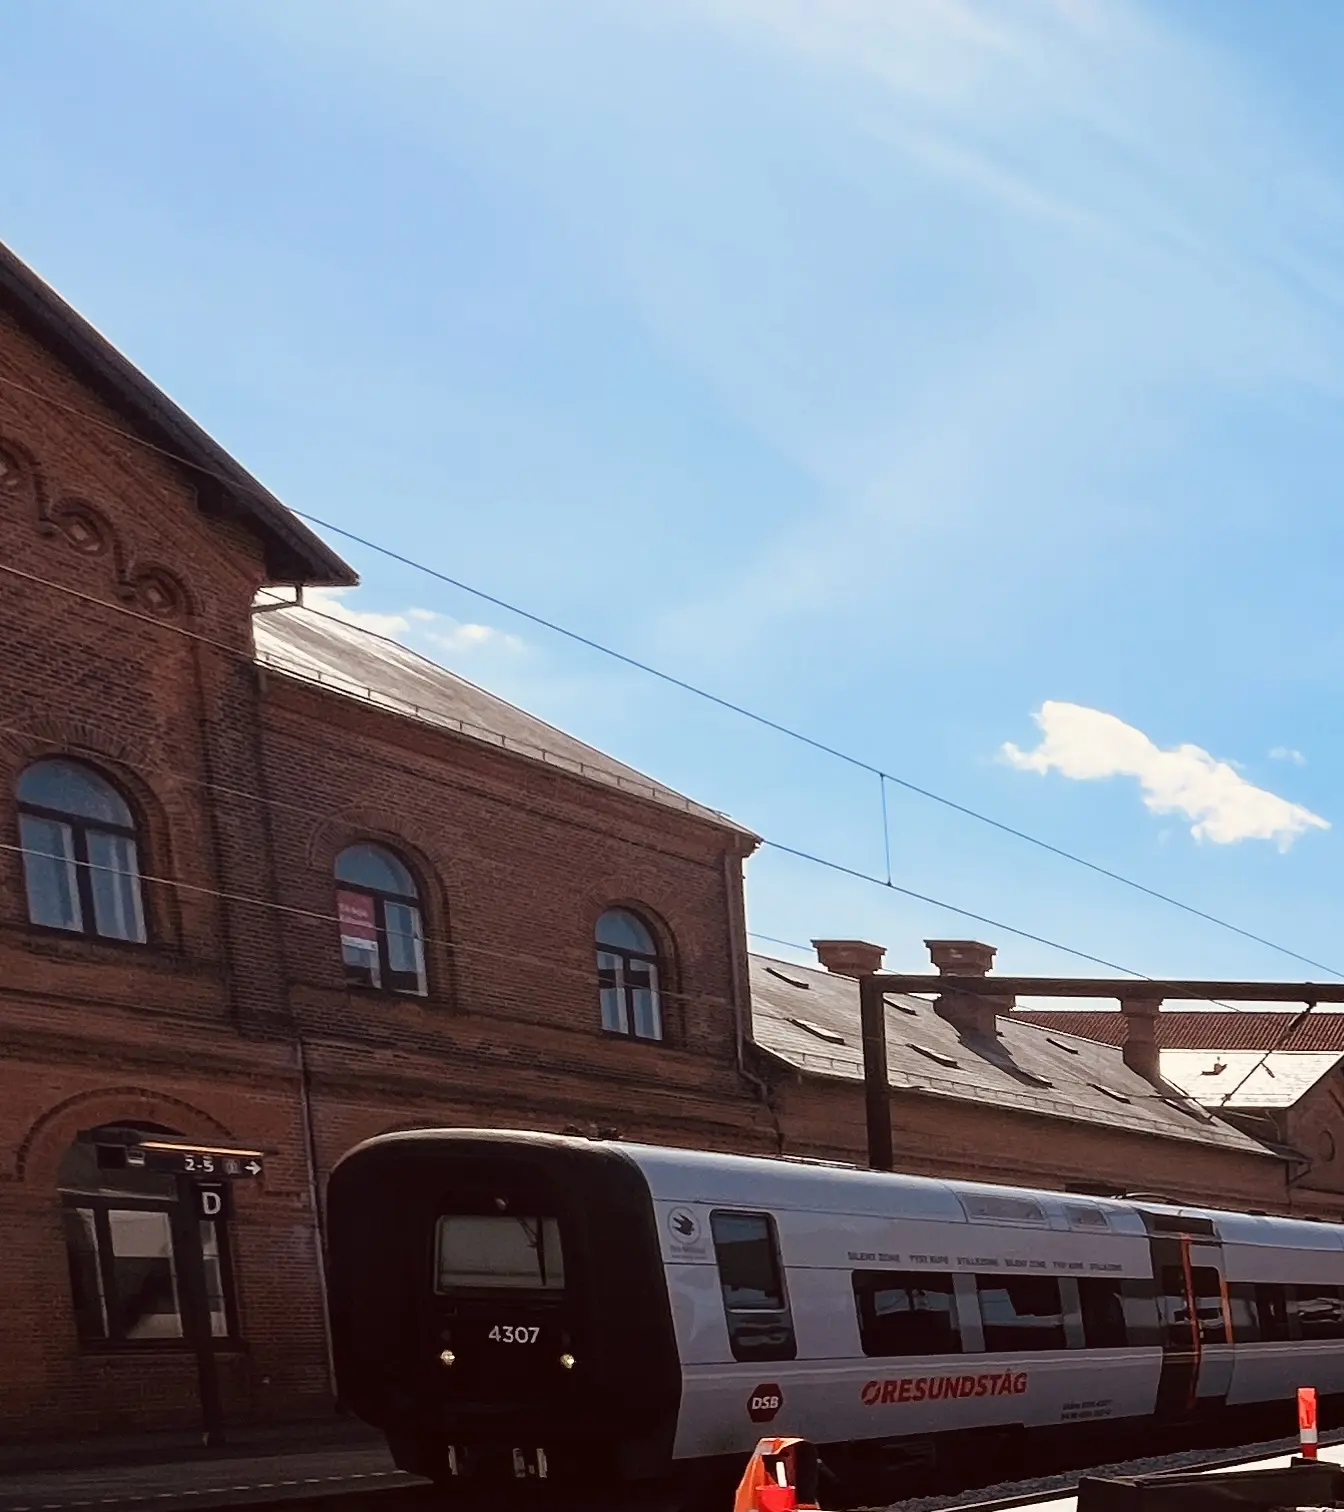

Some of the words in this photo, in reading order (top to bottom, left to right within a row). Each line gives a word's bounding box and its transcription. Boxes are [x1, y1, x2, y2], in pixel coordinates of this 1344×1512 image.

[184, 1157, 215, 1173] 2-5
[202, 1191, 222, 1215] D
[488, 1325, 541, 1344] 4307
[861, 1368, 1028, 1406] ØRESUNDSTÅG
[752, 1396, 779, 1410] DSB
